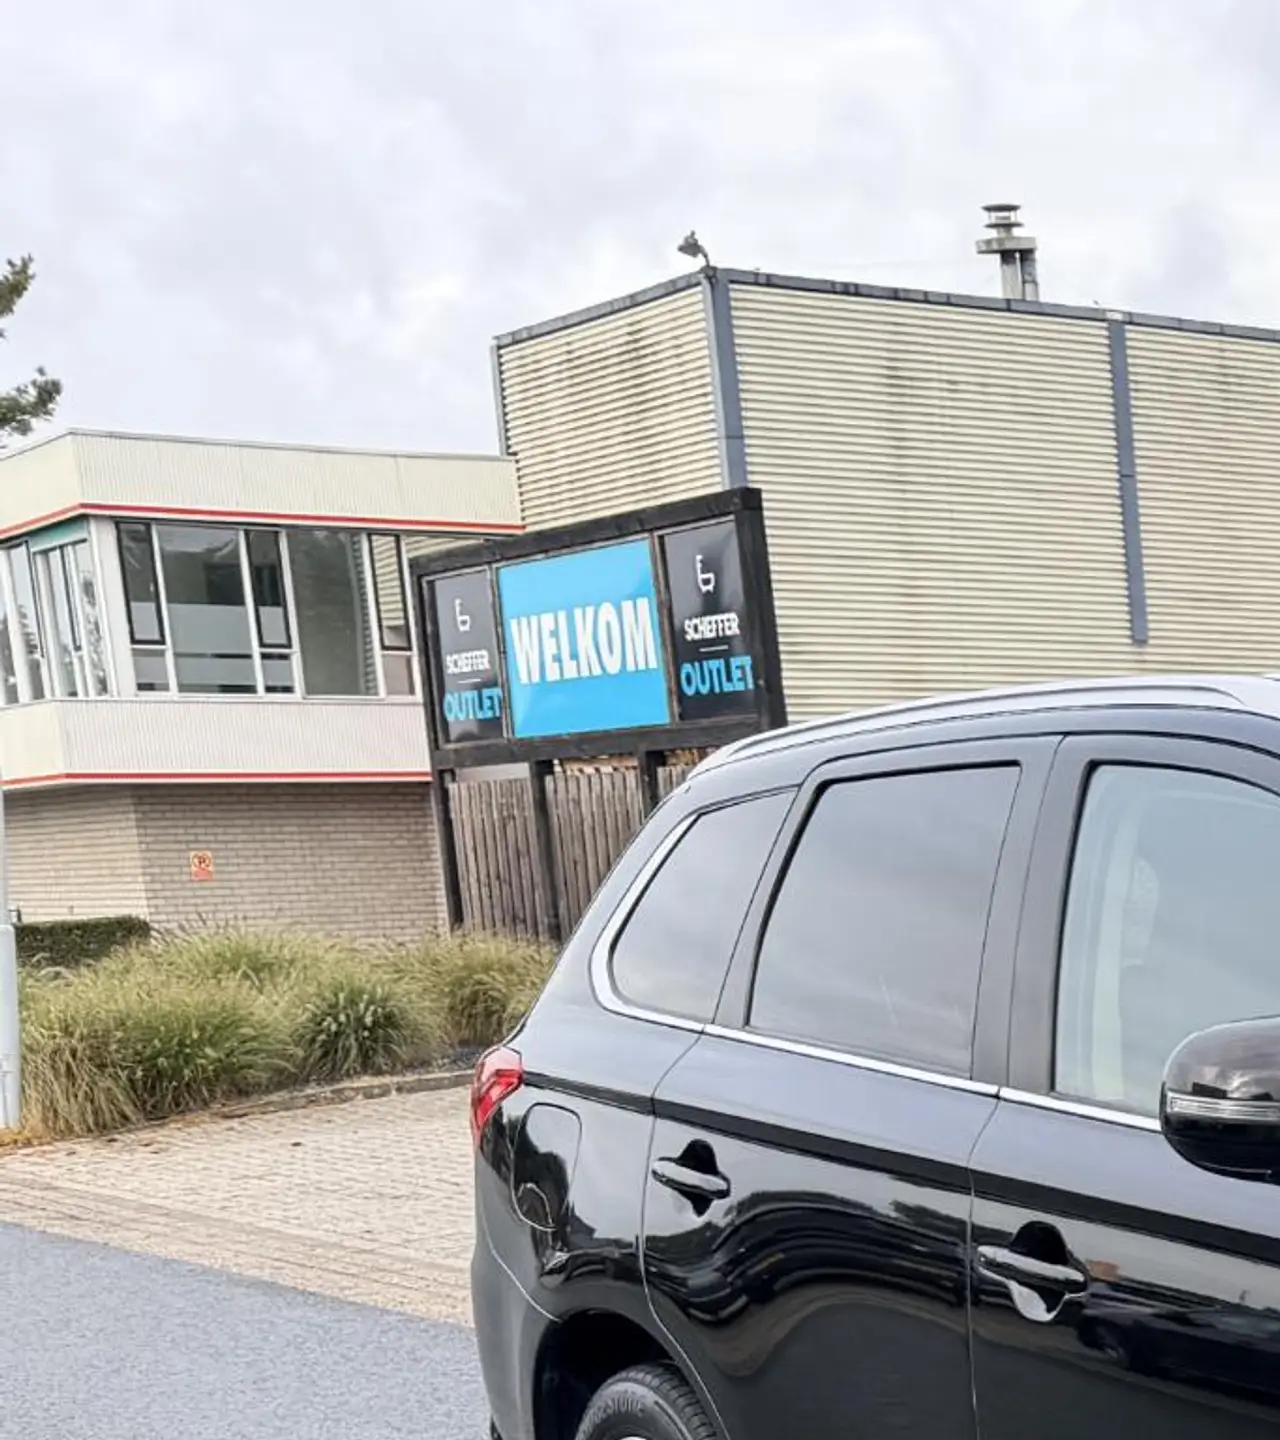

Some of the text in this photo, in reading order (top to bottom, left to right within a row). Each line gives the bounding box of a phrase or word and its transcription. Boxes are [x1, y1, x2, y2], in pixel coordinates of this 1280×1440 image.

[509, 596, 659, 686] WELKOM
[684, 611, 741, 642] SCHEFFER
[445, 650, 491, 675] SCHEFFER
[679, 654, 754, 697] OUTLET
[443, 687, 504, 722] OUTLET
